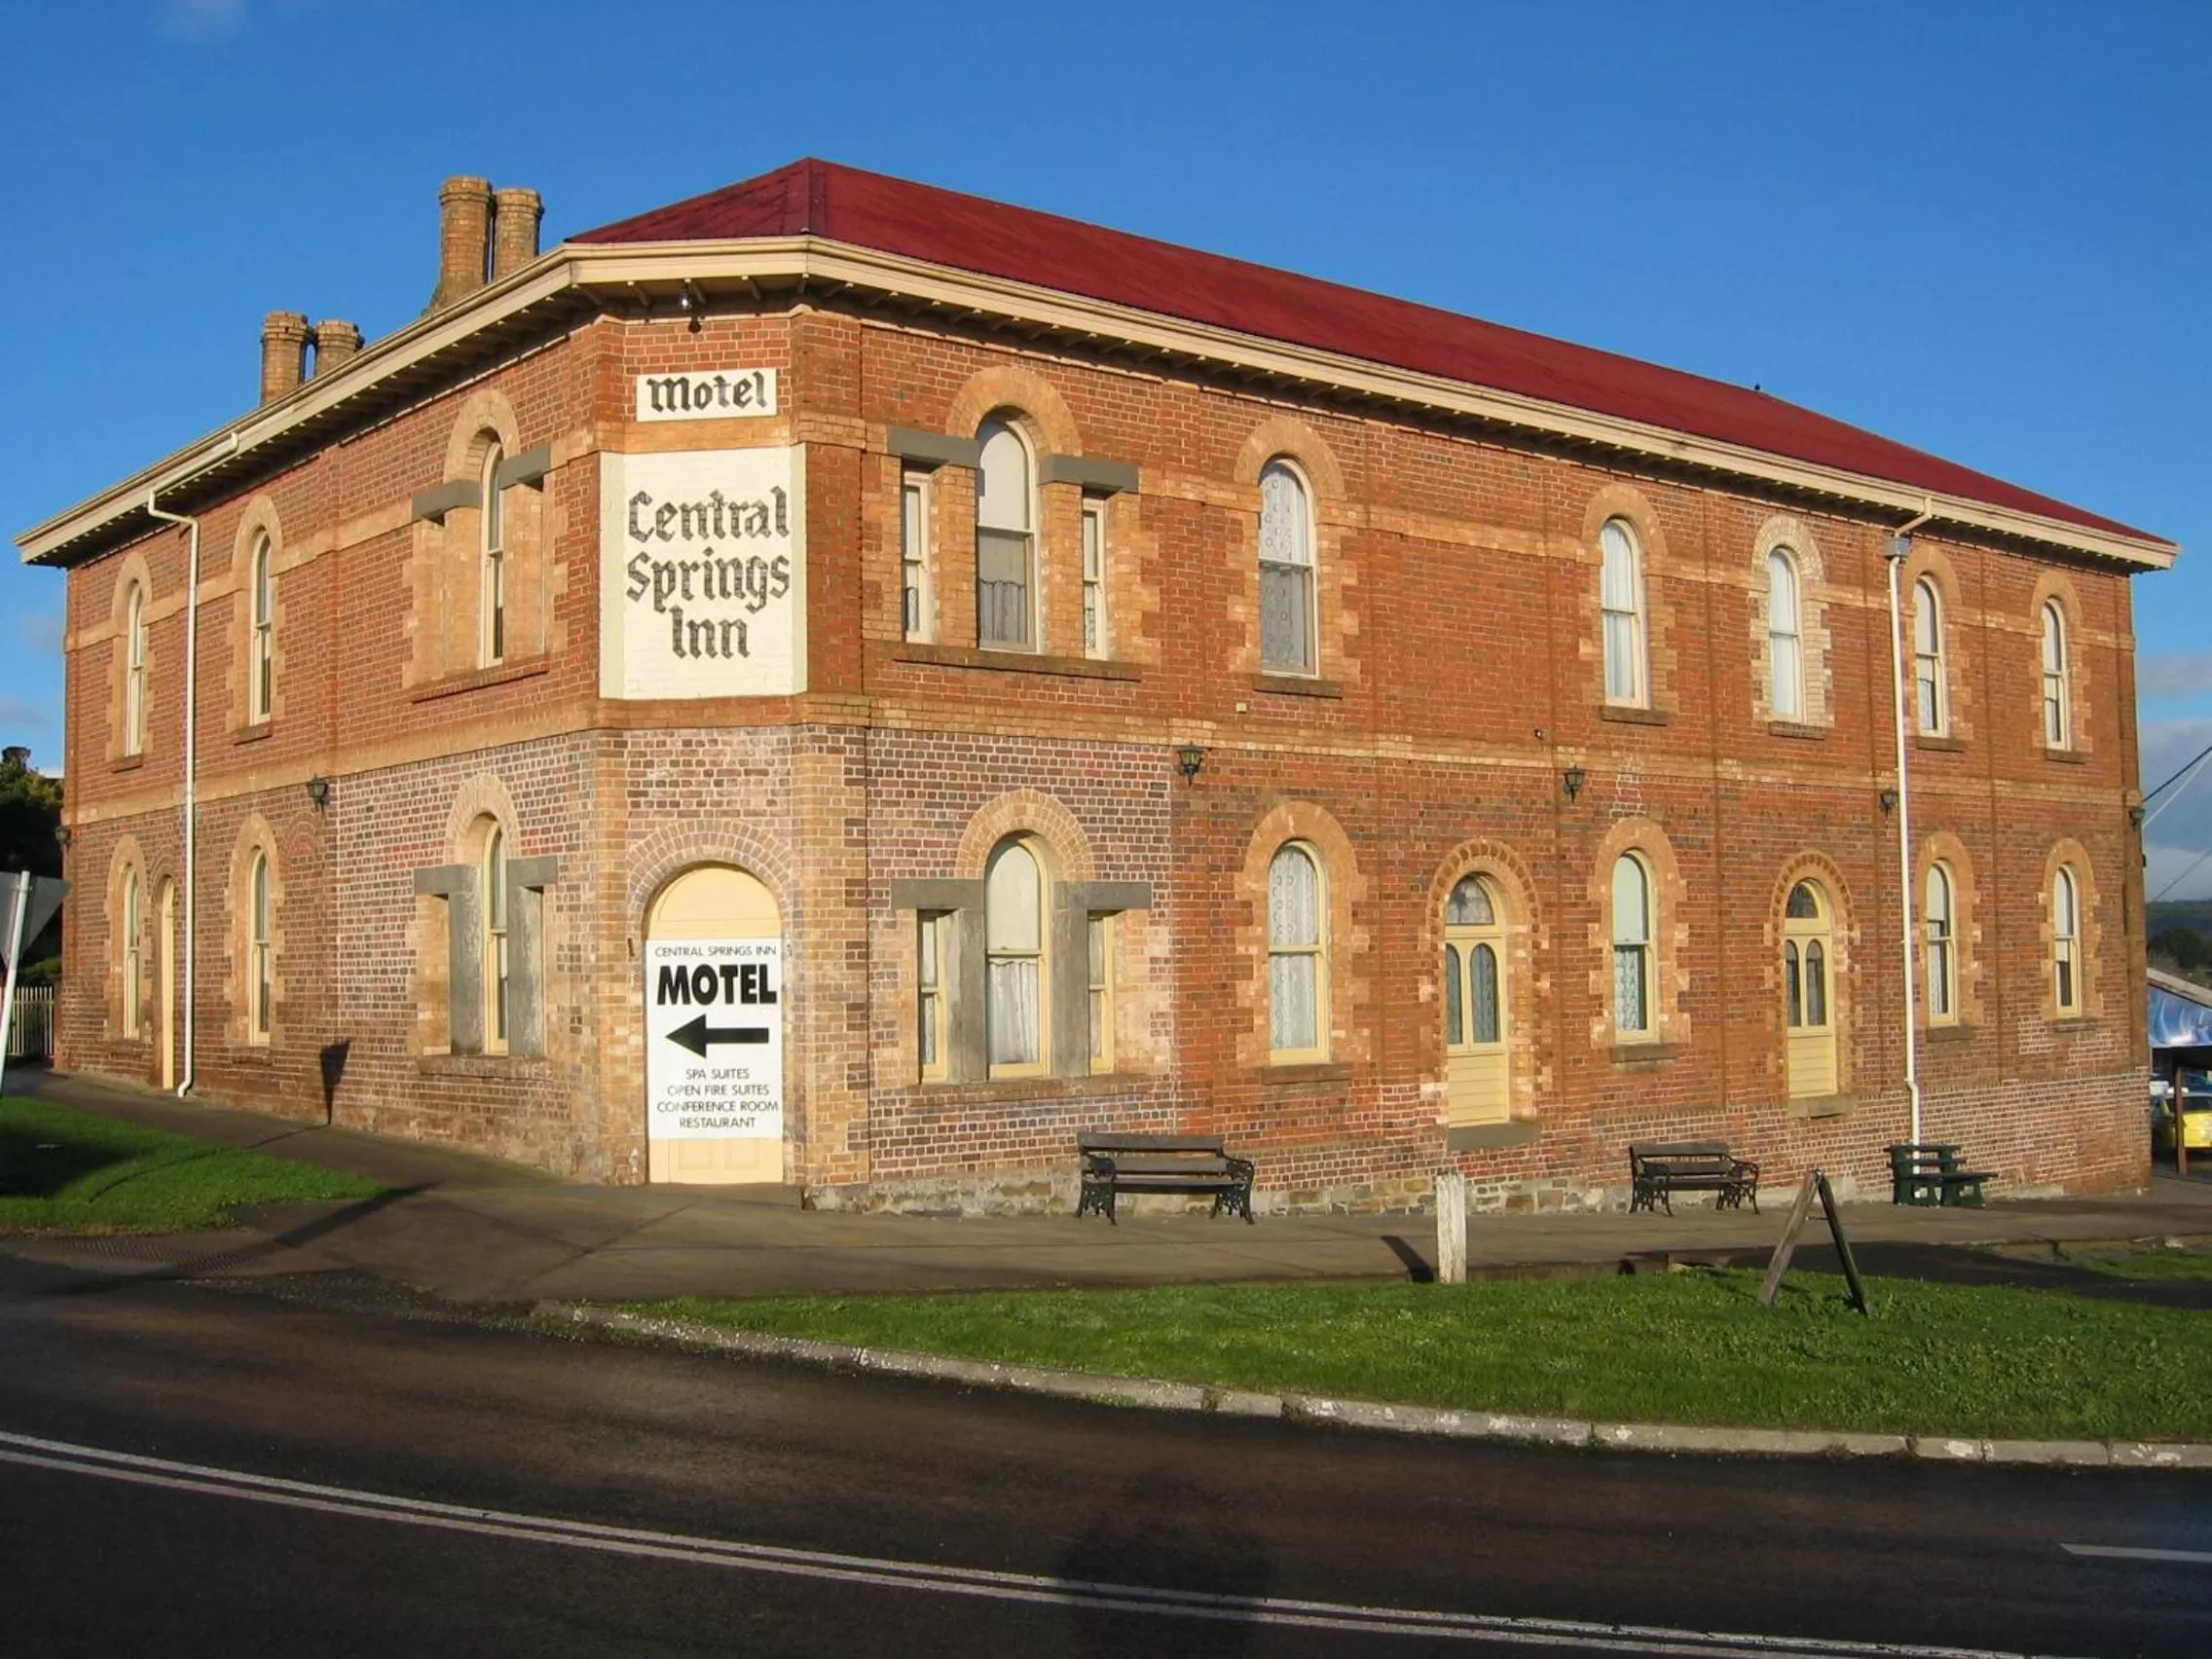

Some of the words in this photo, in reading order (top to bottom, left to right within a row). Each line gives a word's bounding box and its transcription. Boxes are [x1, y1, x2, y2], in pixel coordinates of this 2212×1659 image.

[628, 486, 790, 542] Central
[626, 546, 790, 614] Springs
[669, 604, 751, 659] Inn
[654, 946, 704, 957] CENTRAL
[708, 945, 752, 957] SPRINGS
[756, 945, 777, 956] INN
[657, 964, 778, 1006] MOTEL
[685, 1069, 706, 1080] SPA
[712, 1068, 750, 1080] SUITES
[667, 1086, 701, 1096] OPEN
[705, 1085, 727, 1096] FIRE
[732, 1085, 770, 1096] SUITES
[657, 1101, 736, 1113] CONFERENCE
[740, 1100, 779, 1112] ROOM
[679, 1117, 756, 1129] RESTAURANT
